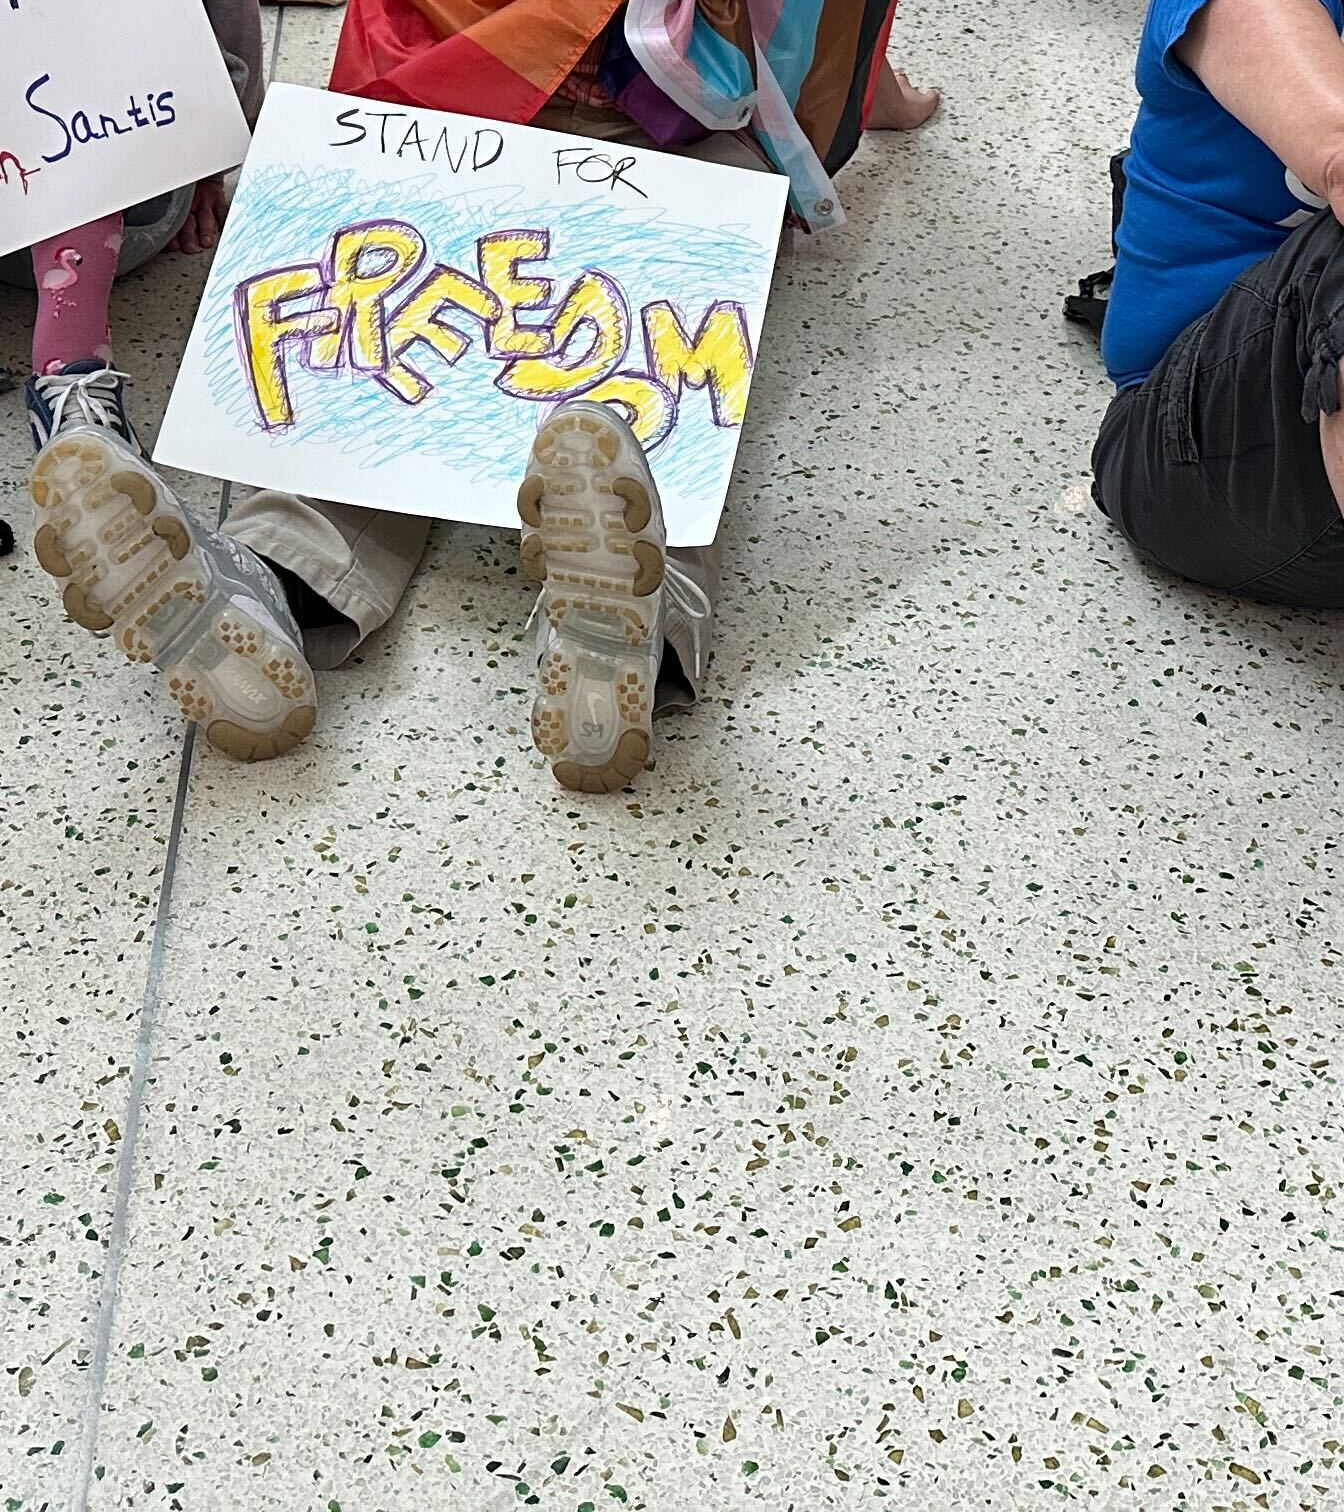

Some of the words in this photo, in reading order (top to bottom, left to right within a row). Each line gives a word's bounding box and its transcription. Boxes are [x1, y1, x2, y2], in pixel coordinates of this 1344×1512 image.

[25, 73, 176, 164] Santis
[329, 107, 504, 174] STAND
[552, 146, 648, 198] FOR
[233, 218, 757, 456] FREEDOM
